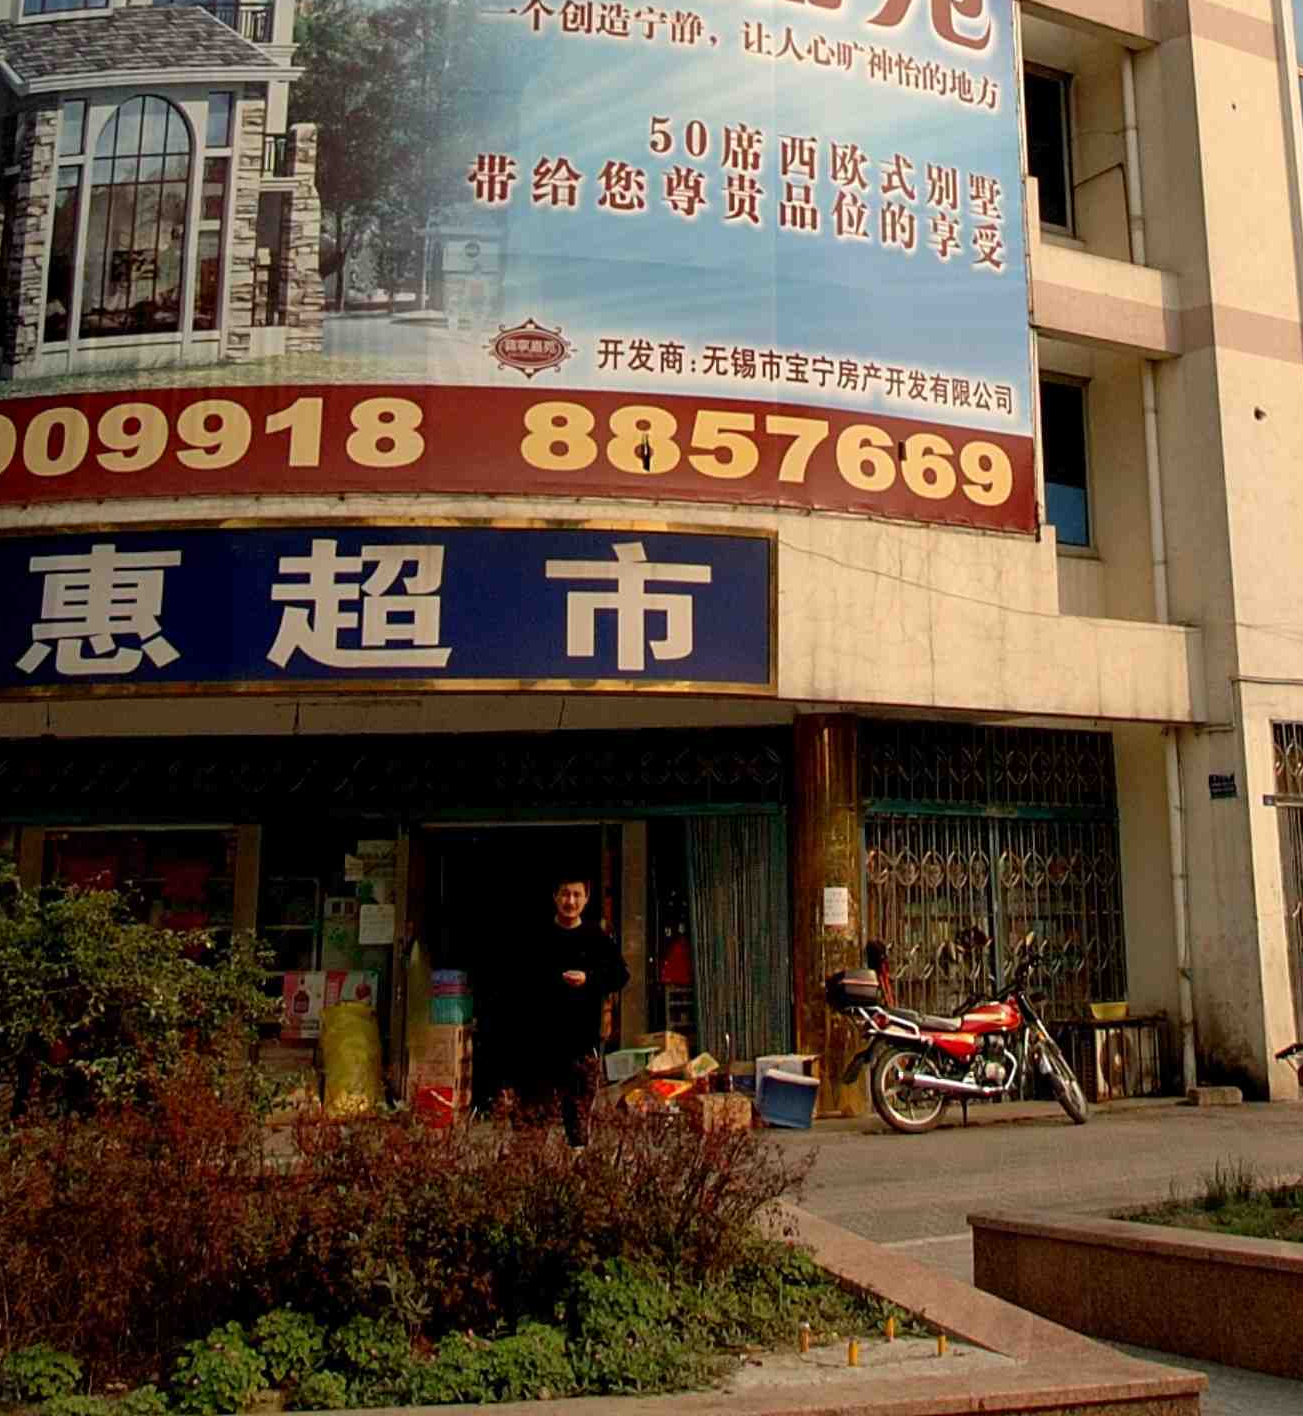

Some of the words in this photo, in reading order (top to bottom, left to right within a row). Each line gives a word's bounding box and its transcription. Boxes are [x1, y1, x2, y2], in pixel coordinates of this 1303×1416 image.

[467, 153, 1006, 271] 带给您尊贵品位的享受
[520, 400, 1014, 507] 8857669
